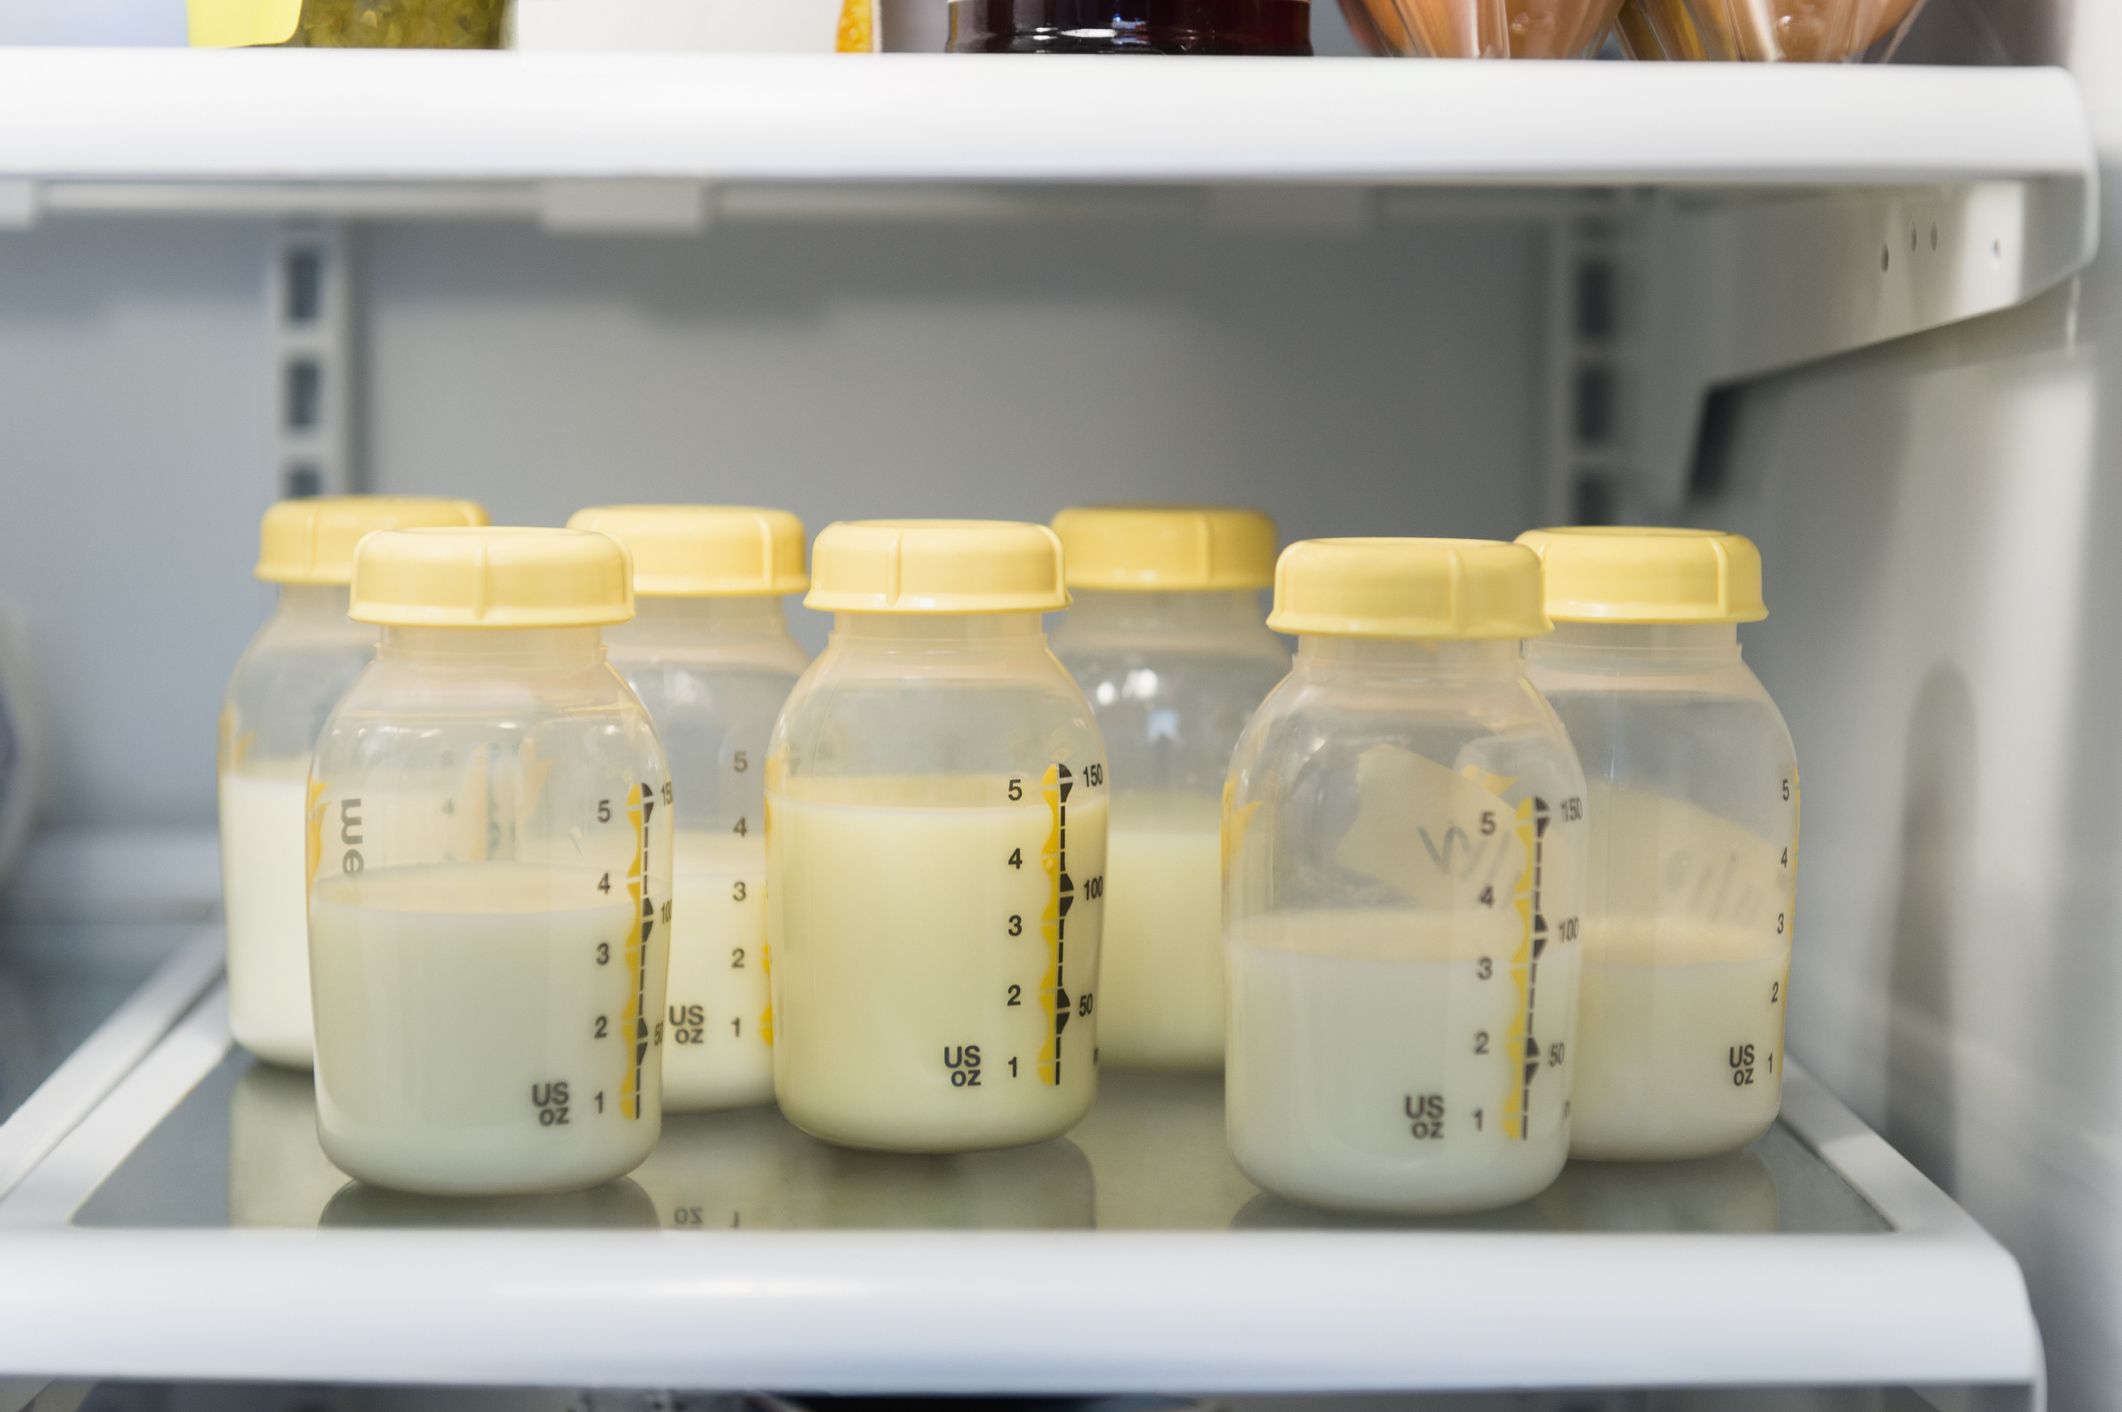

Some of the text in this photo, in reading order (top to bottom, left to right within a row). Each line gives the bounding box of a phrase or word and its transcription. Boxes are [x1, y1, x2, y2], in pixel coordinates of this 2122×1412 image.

[733, 752, 748, 772] 5
[1083, 763, 1104, 788] 150
[1008, 779, 1023, 801] 5
[1782, 778, 1790, 802] 5
[597, 799, 611, 824] 5
[1561, 797, 1583, 823] 150
[733, 817, 748, 837] 4
[1480, 811, 1496, 836] 5
[1008, 848, 1023, 870] 4
[1780, 847, 1788, 869] 4
[597, 872, 611, 895] 4
[732, 881, 747, 901] 3
[1083, 876, 1104, 901] 100
[1478, 886, 1495, 909] 4
[661, 899, 672, 925] 10
[1776, 913, 1785, 934] 3
[1008, 915, 1023, 937] 3
[1558, 916, 1580, 942] 100
[596, 942, 610, 966] 3
[731, 948, 746, 968] 2
[1477, 956, 1493, 981] 3
[1007, 984, 1022, 1006] 2
[1771, 981, 1779, 1003] 2
[668, 1005, 704, 1027] US
[1079, 993, 1094, 1017] 50
[594, 1016, 609, 1039] 2
[731, 1017, 741, 1038] 1
[1474, 1031, 1490, 1055] 2
[944, 1045, 982, 1069] US
[1548, 1042, 1565, 1068] 50
[1728, 1044, 1756, 1069] US
[1768, 1053, 1774, 1075] 1
[1007, 1056, 1018, 1078] 1
[531, 1081, 570, 1107] US
[595, 1091, 604, 1114] 1
[1404, 1094, 1446, 1120] US
[1474, 1107, 1484, 1132] 1
